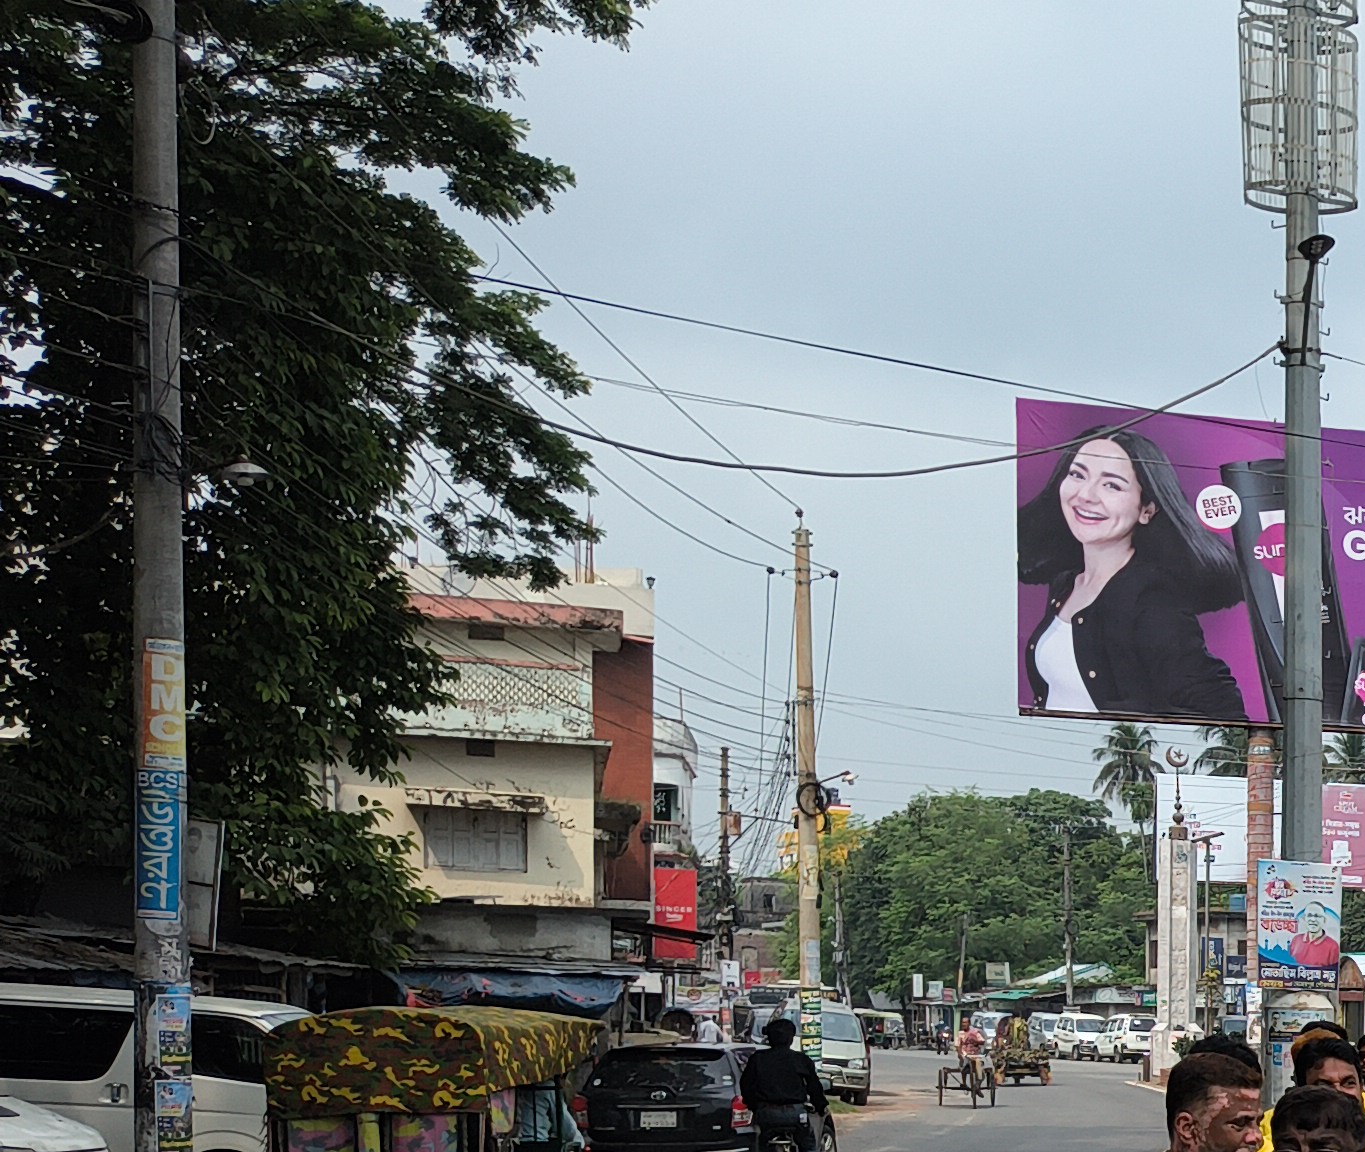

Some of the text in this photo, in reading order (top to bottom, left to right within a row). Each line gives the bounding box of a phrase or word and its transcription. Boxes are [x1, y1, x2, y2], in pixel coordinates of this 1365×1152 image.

[1202, 494, 1235, 510] BEST
[1204, 505, 1237, 520] EVER
[150, 653, 184, 742] DMC
[137, 771, 178, 789] BCS
